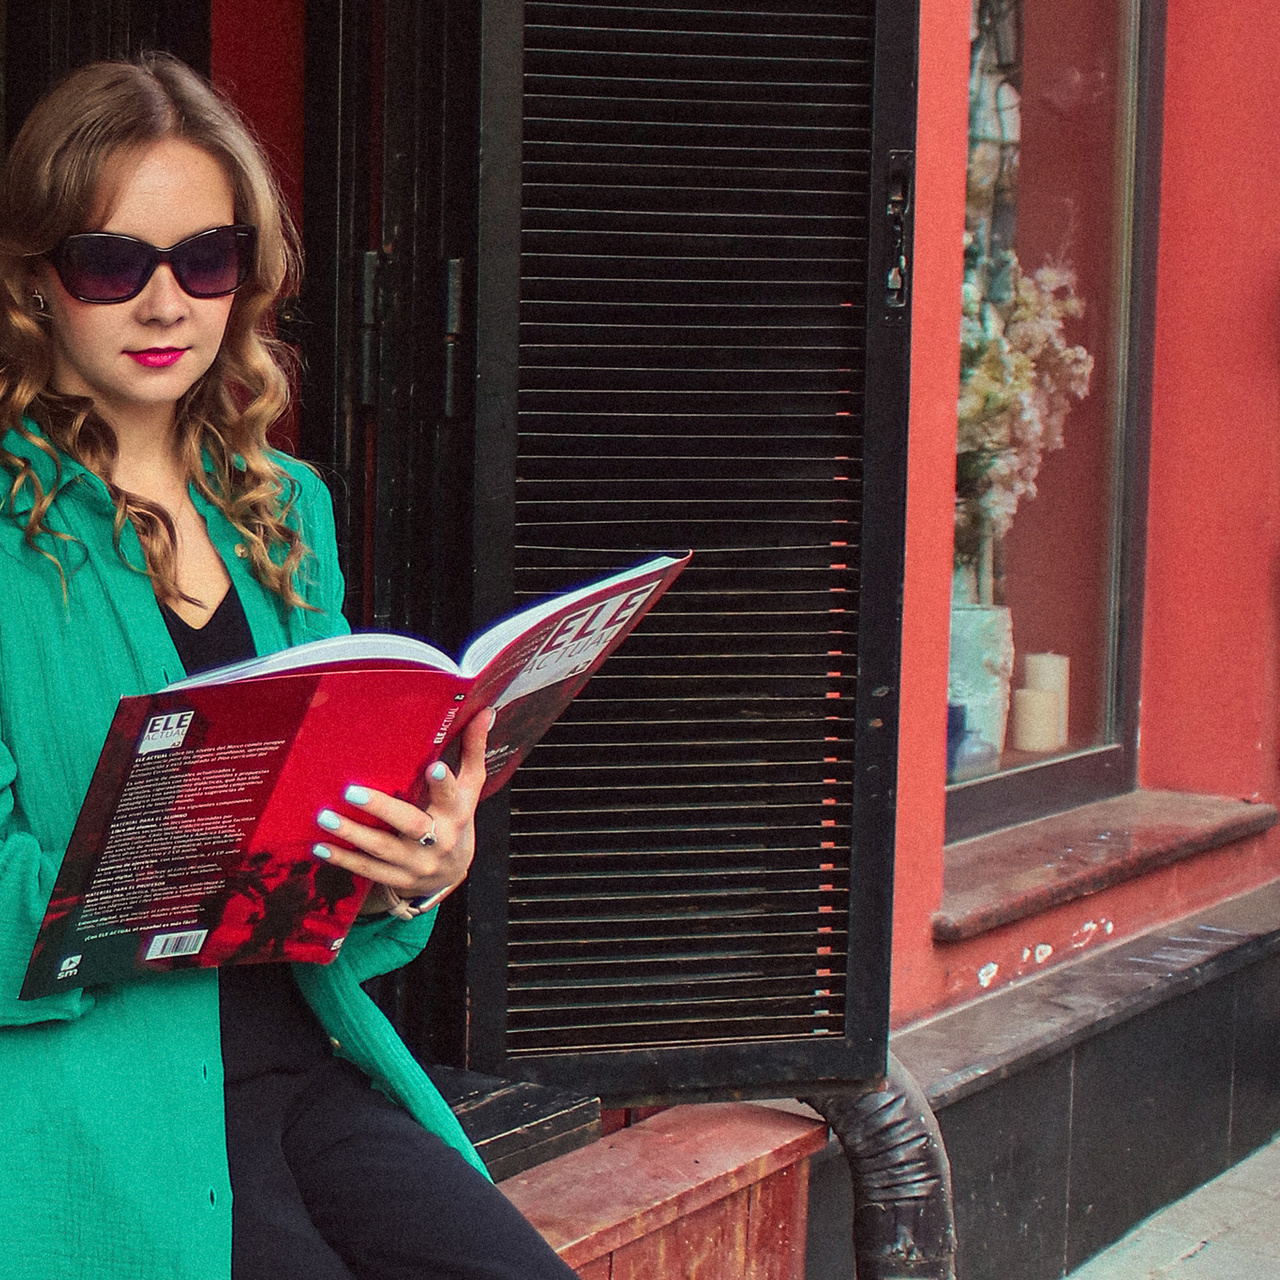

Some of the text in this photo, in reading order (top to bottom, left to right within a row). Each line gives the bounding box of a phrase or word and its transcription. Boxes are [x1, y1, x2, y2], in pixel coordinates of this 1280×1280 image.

[538, 586, 652, 657] ELE
[523, 624, 622, 675] ACTUAL
[144, 728, 187, 741] ACTUAL
[149, 713, 192, 734] ELE
[433, 707, 459, 743] ELE ACTUAL
[57, 968, 79, 980] sm
